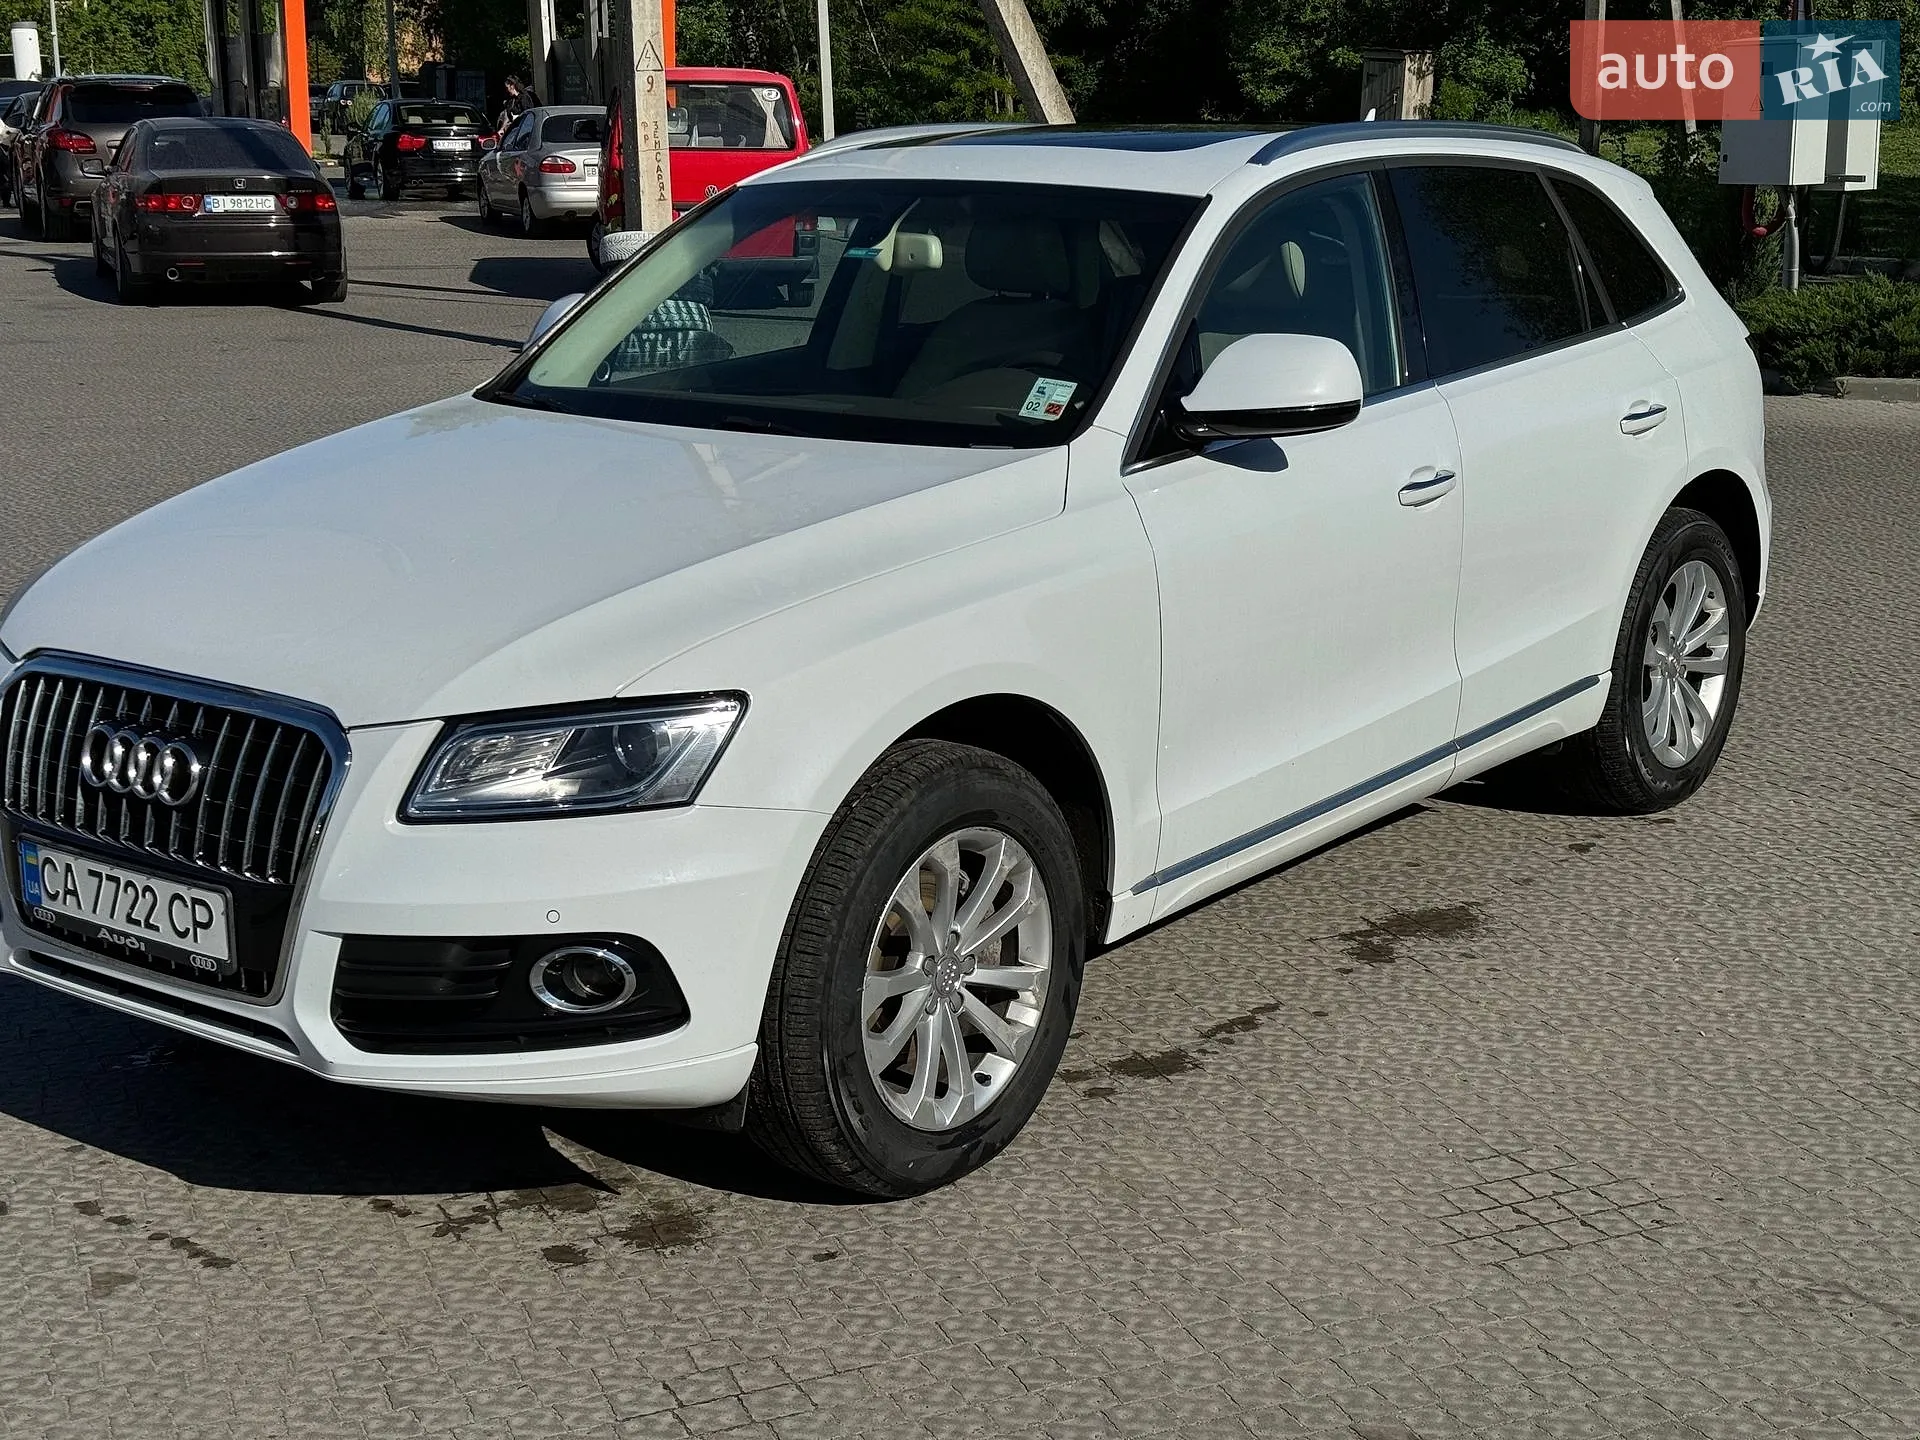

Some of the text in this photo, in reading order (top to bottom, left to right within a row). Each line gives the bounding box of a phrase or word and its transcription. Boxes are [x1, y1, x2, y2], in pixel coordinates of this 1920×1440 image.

[646, 75, 654, 93] 9
[1026, 401, 1041, 412] 02
[27, 879, 40, 895] UA
[41, 856, 214, 944] CA 7722 CP
[97, 928, 146, 951] Audi
